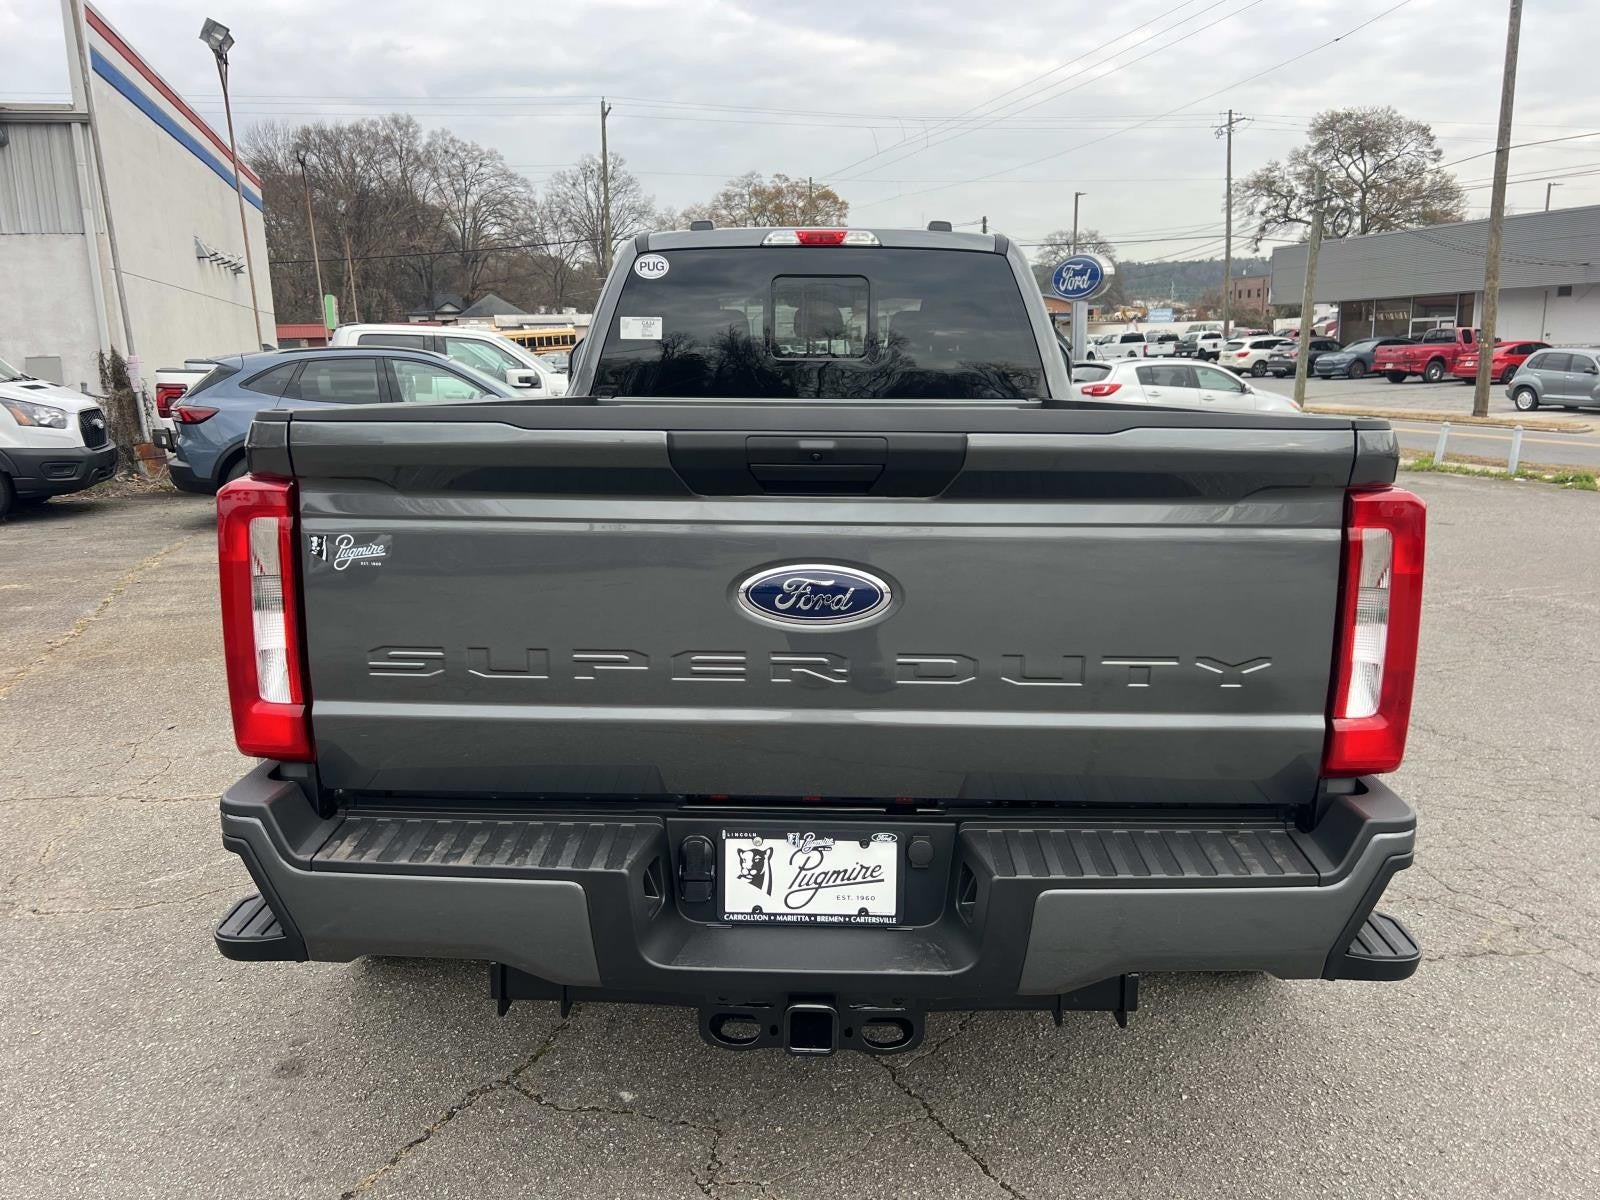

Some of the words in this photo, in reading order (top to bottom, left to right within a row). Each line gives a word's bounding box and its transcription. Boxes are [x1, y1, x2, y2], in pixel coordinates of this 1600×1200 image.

[639, 261, 665, 272] PUG
[1060, 264, 1092, 291] Ford
[334, 534, 386, 570] Pugmire
[774, 577, 856, 611] Ford
[367, 645, 849, 683] SUPER
[896, 653, 1273, 688] DUTY
[784, 847, 885, 910] Pugmire
[723, 913, 769, 921] CARROLLTON
[776, 914, 810, 922] MARIETTA
[816, 915, 844, 923] BREMEN
[850, 916, 897, 924] CARTERSVILLE
